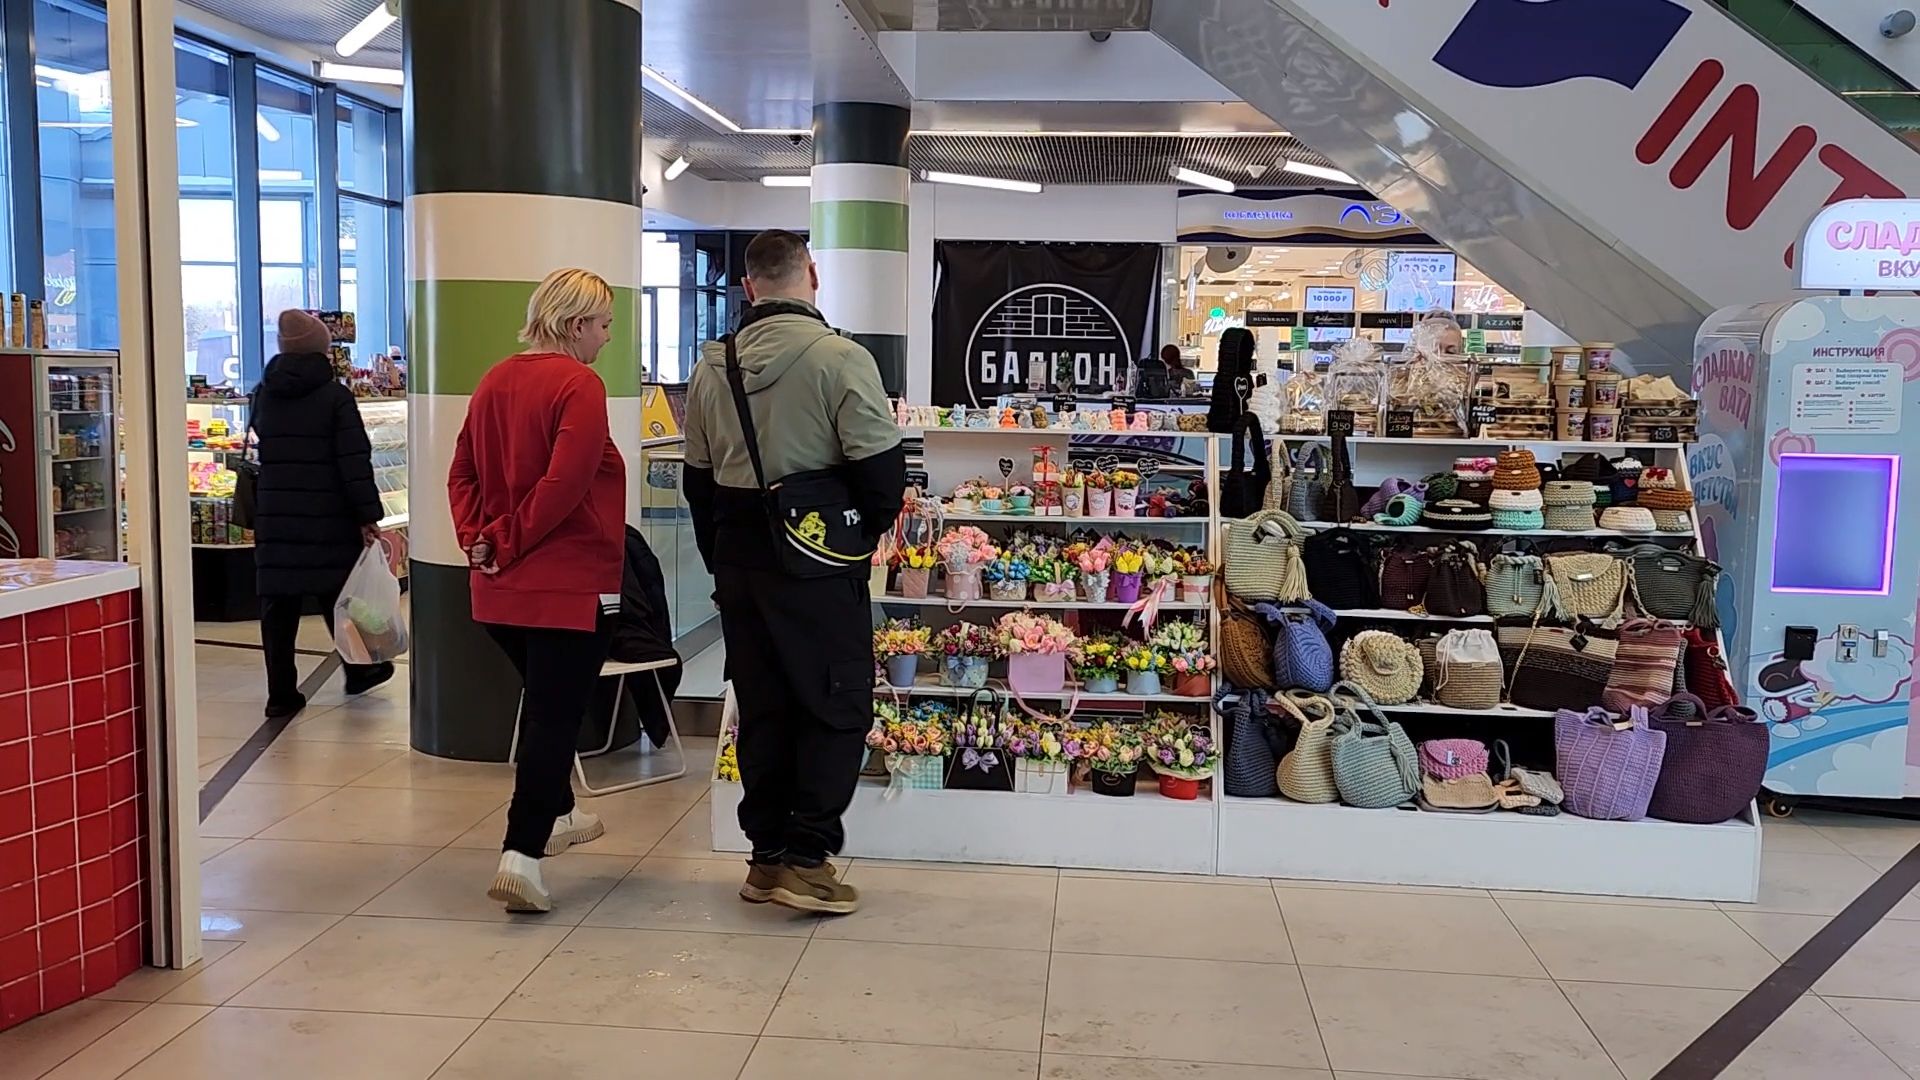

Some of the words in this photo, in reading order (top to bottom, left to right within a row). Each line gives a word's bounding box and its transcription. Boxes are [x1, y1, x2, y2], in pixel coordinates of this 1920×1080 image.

[1812, 347, 1885, 359] ИНСТРУКЦИЯ
[1692, 350, 1755, 392] СЛАДКАЯ
[1718, 385, 1752, 430] ВАТА
[1331, 421, 1351, 431] 950
[1690, 444, 1723, 479] ВКУС
